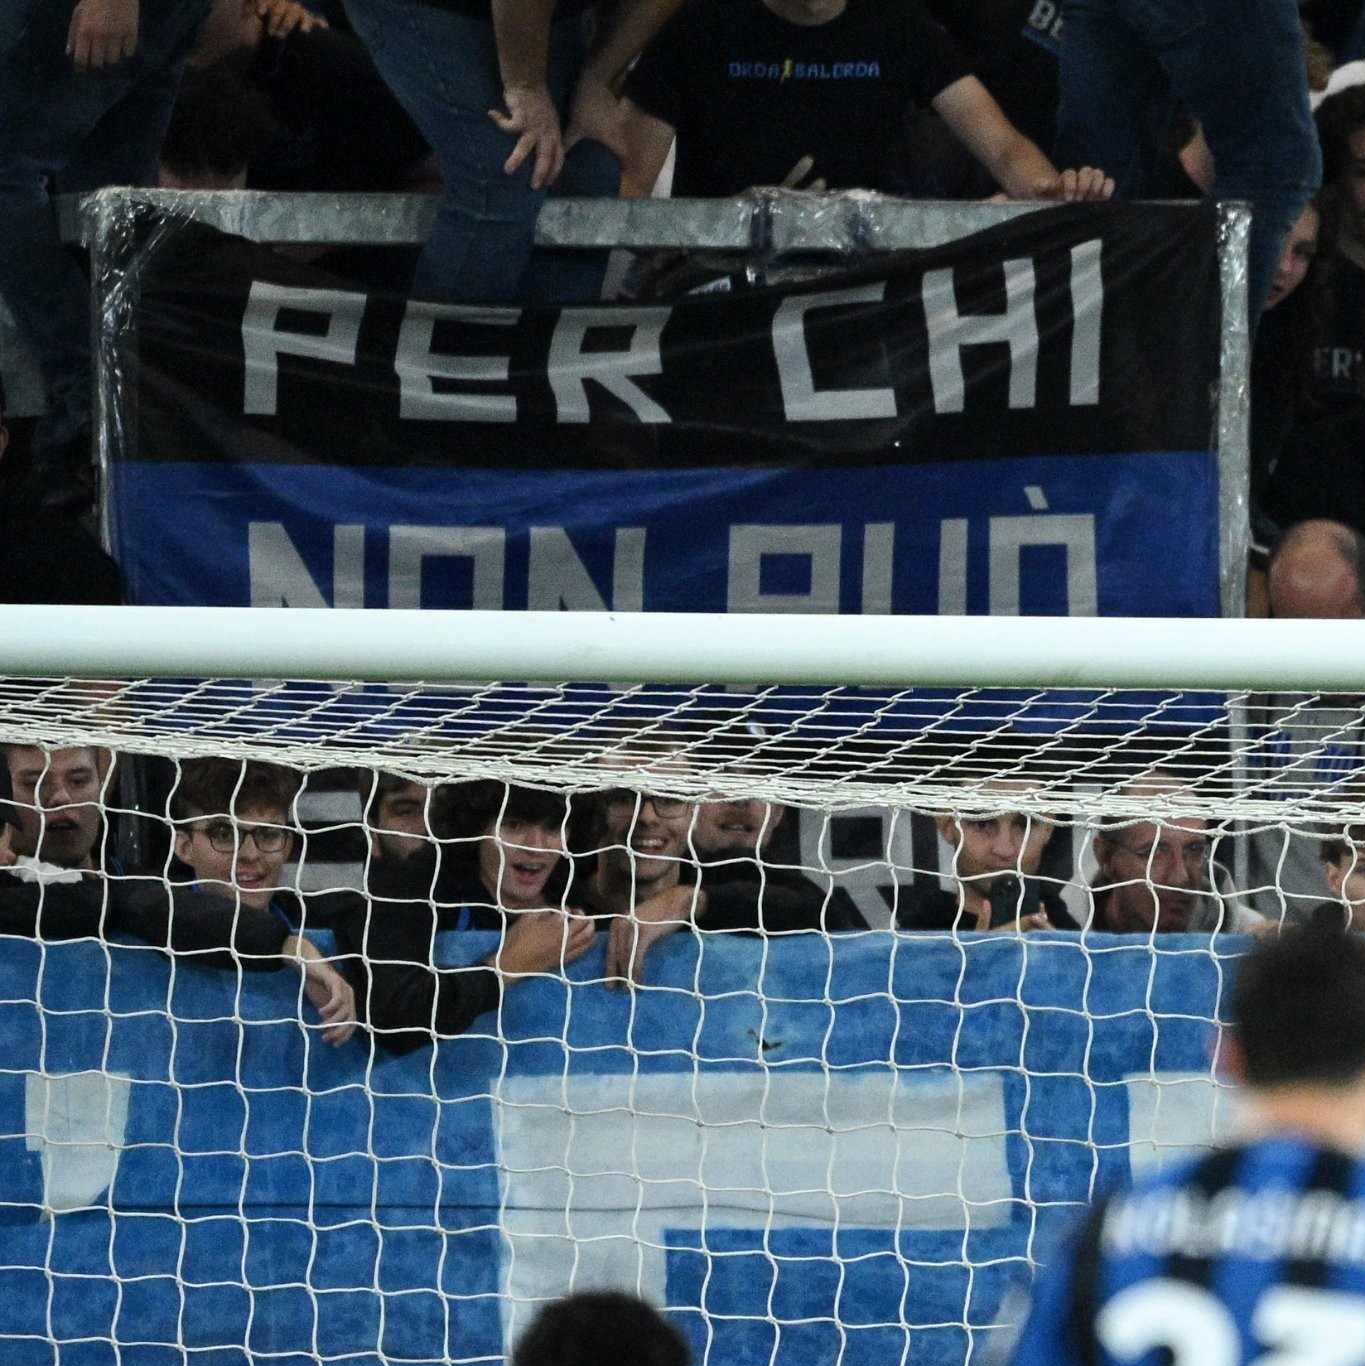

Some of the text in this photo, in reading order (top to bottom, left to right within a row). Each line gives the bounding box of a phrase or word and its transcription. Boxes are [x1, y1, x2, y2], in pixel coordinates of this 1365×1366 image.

[241, 238, 1104, 424] PER CHI
[247, 485, 1099, 617] NON PUÒ
